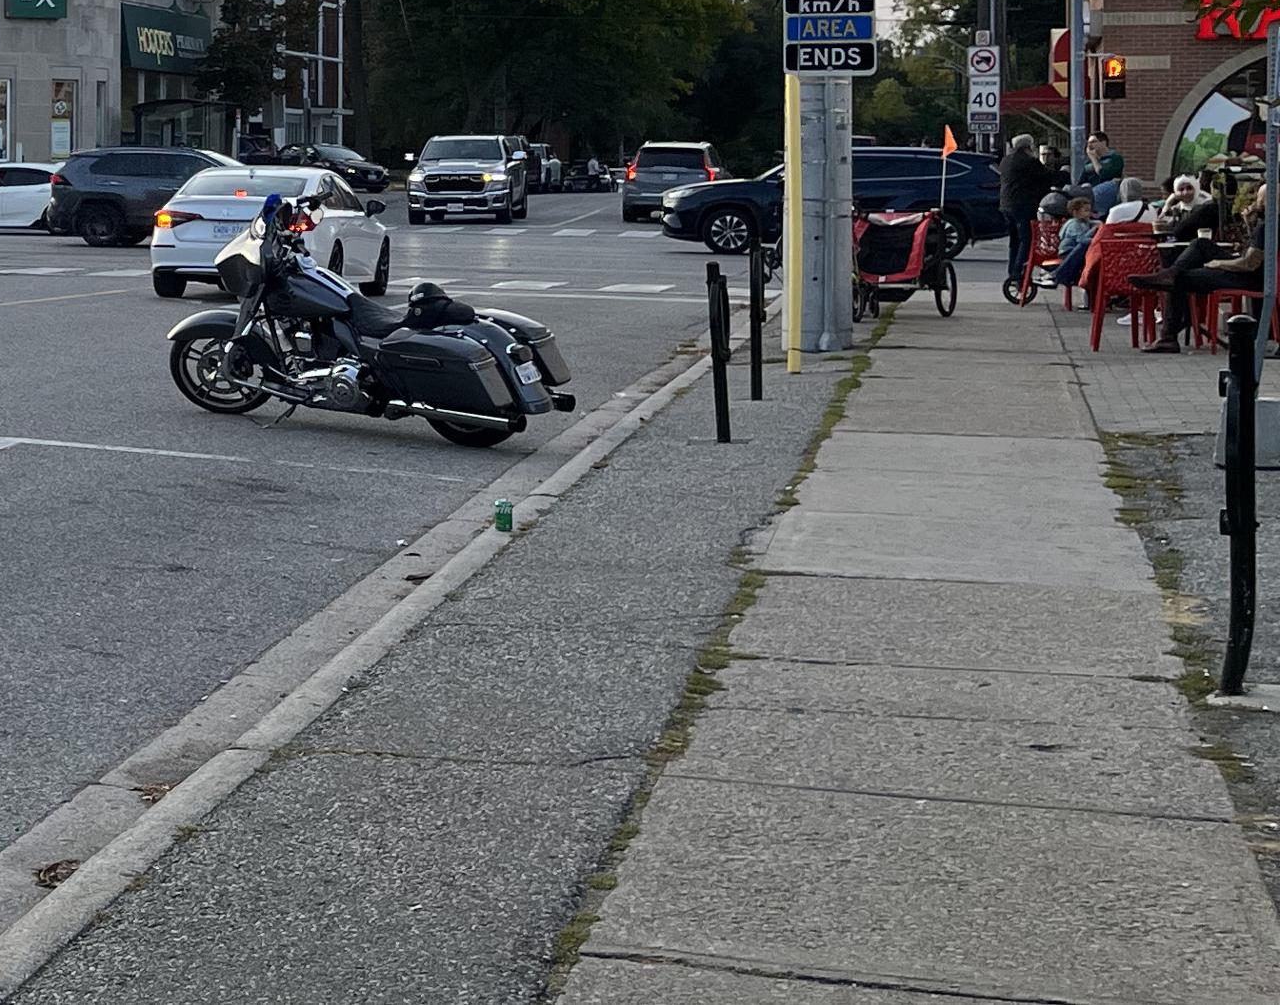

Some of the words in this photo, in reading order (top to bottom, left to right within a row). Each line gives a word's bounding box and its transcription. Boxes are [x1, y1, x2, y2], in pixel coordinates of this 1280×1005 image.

[802, 20, 857, 37] AREA
[799, 47, 862, 66] ENDS
[972, 92, 997, 108] 40
